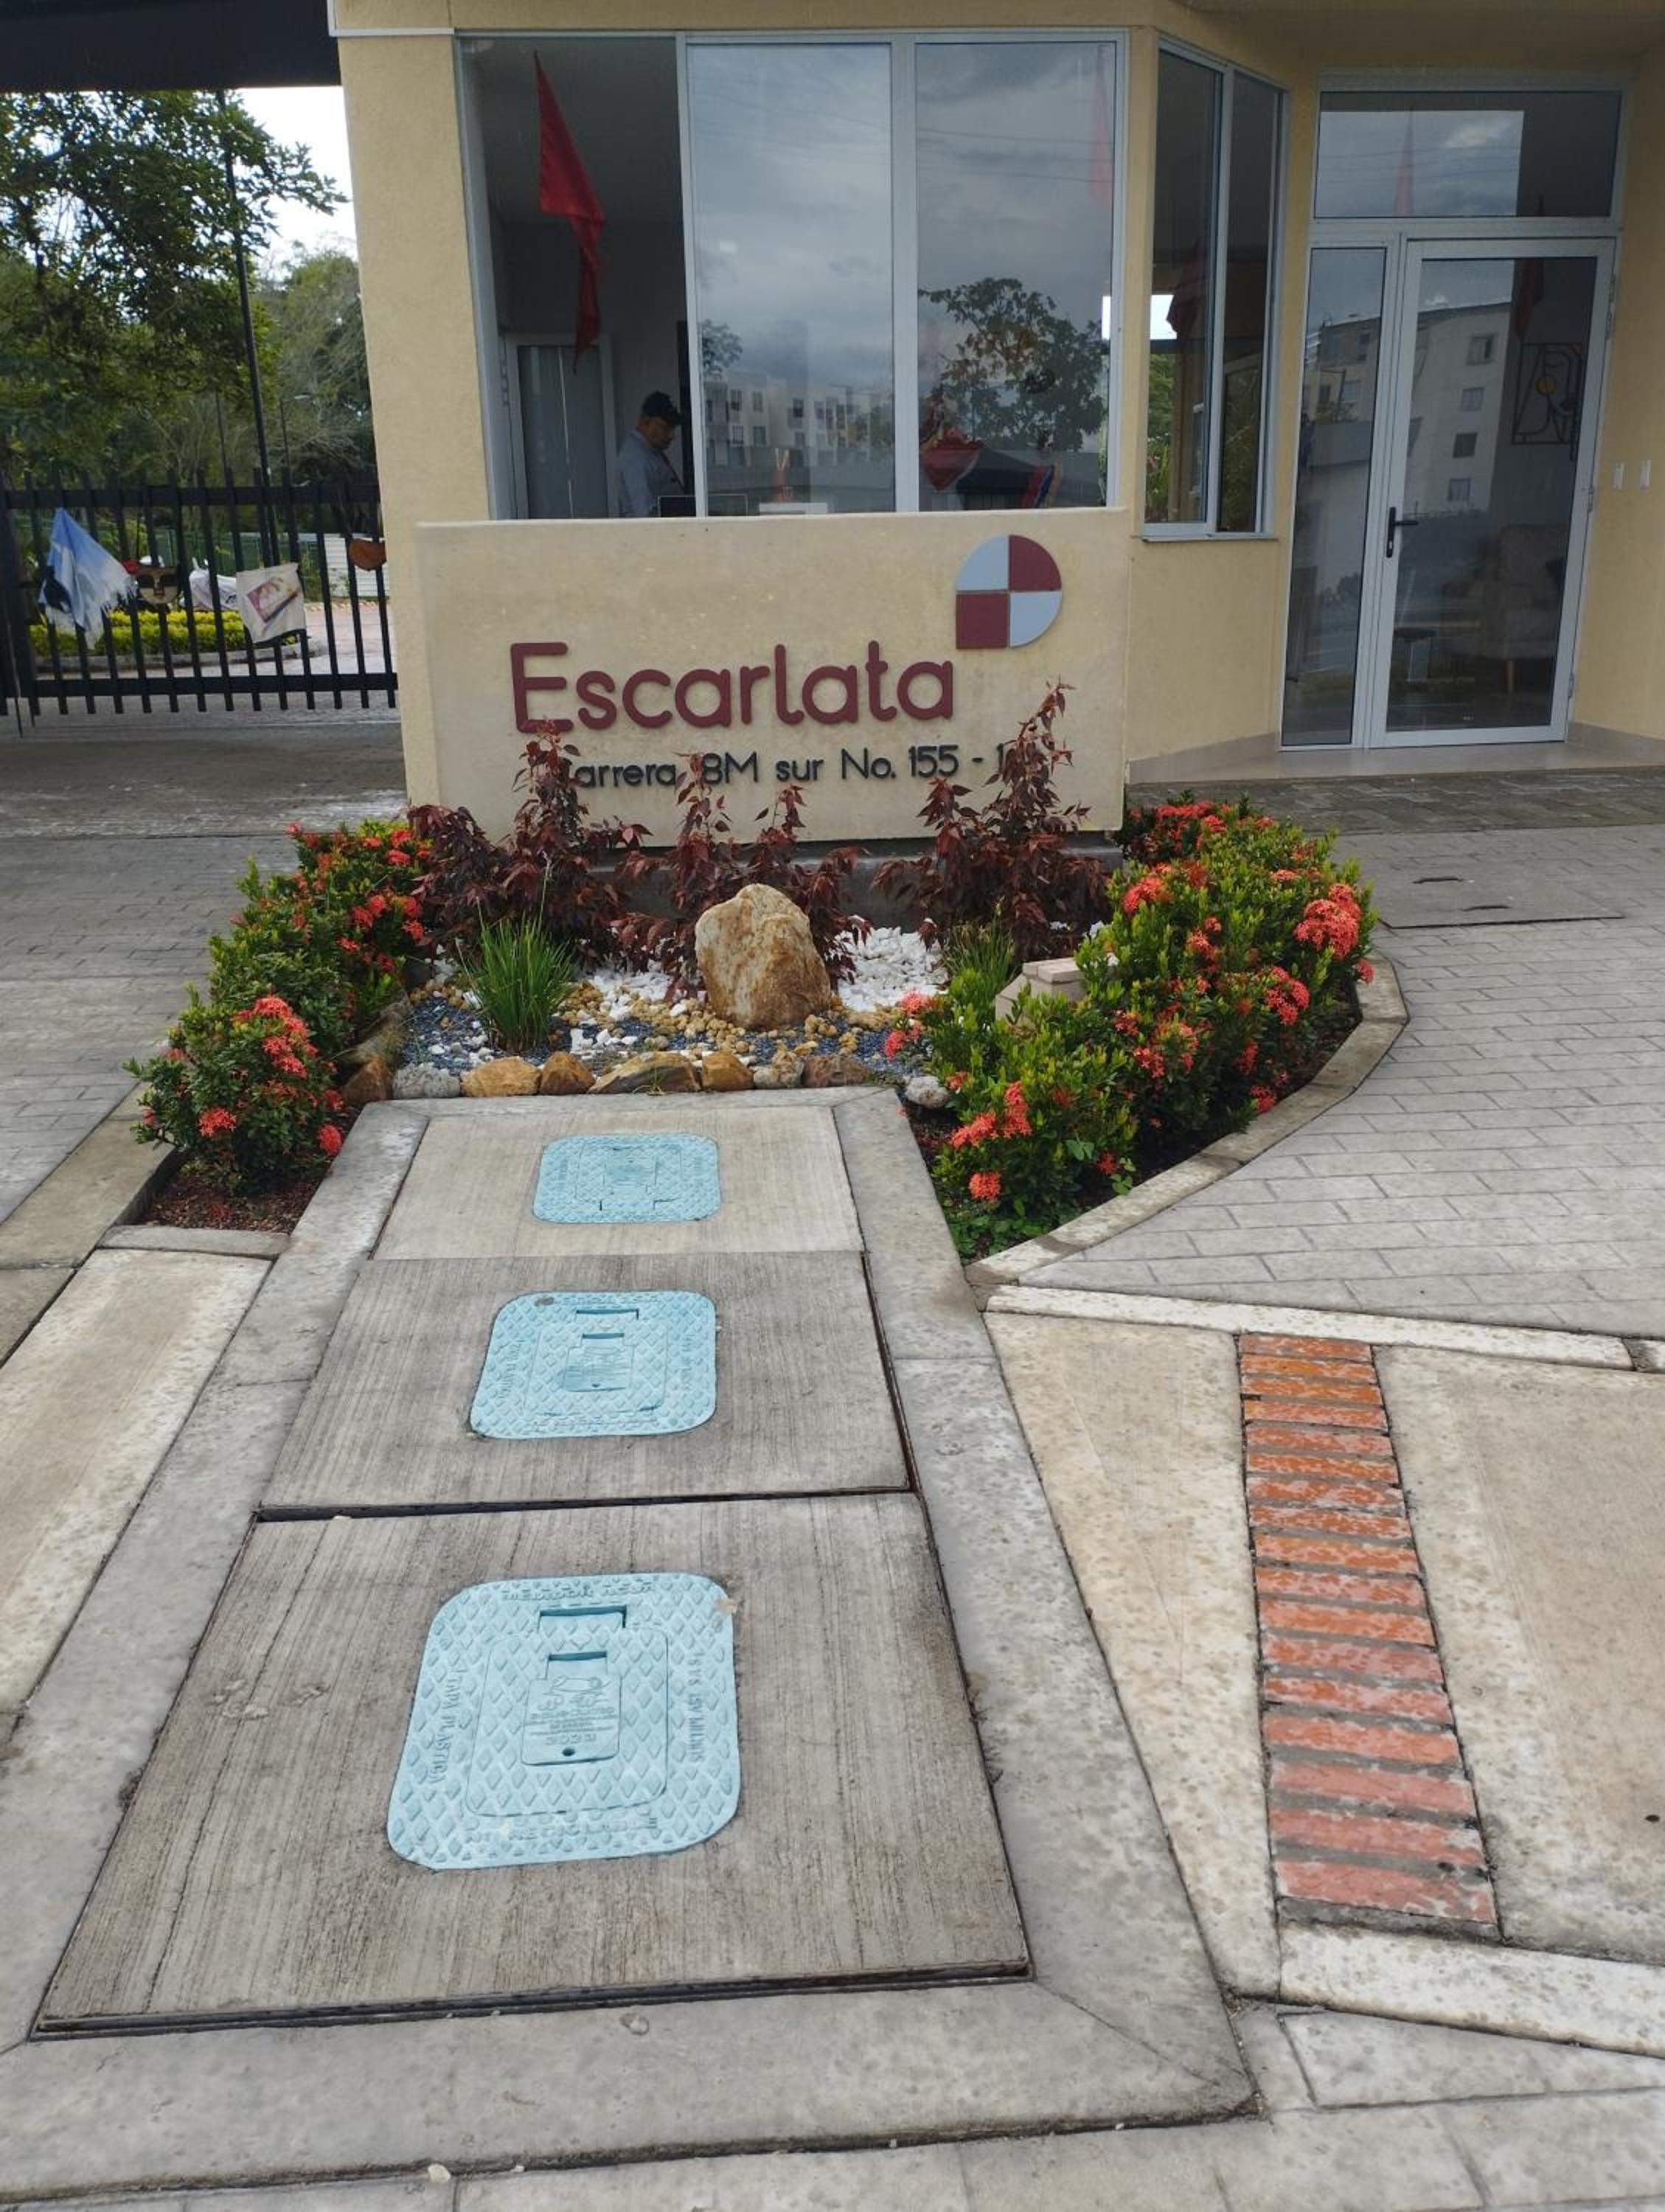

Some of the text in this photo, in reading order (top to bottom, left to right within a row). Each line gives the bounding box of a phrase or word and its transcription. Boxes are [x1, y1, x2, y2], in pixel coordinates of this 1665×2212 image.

[510, 640, 953, 733] Escarlata
[563, 757, 676, 788] arrera
[701, 751, 759, 785] 8M
[775, 758, 824, 782] sur
[841, 747, 897, 779] No.
[908, 745, 959, 778] 155
